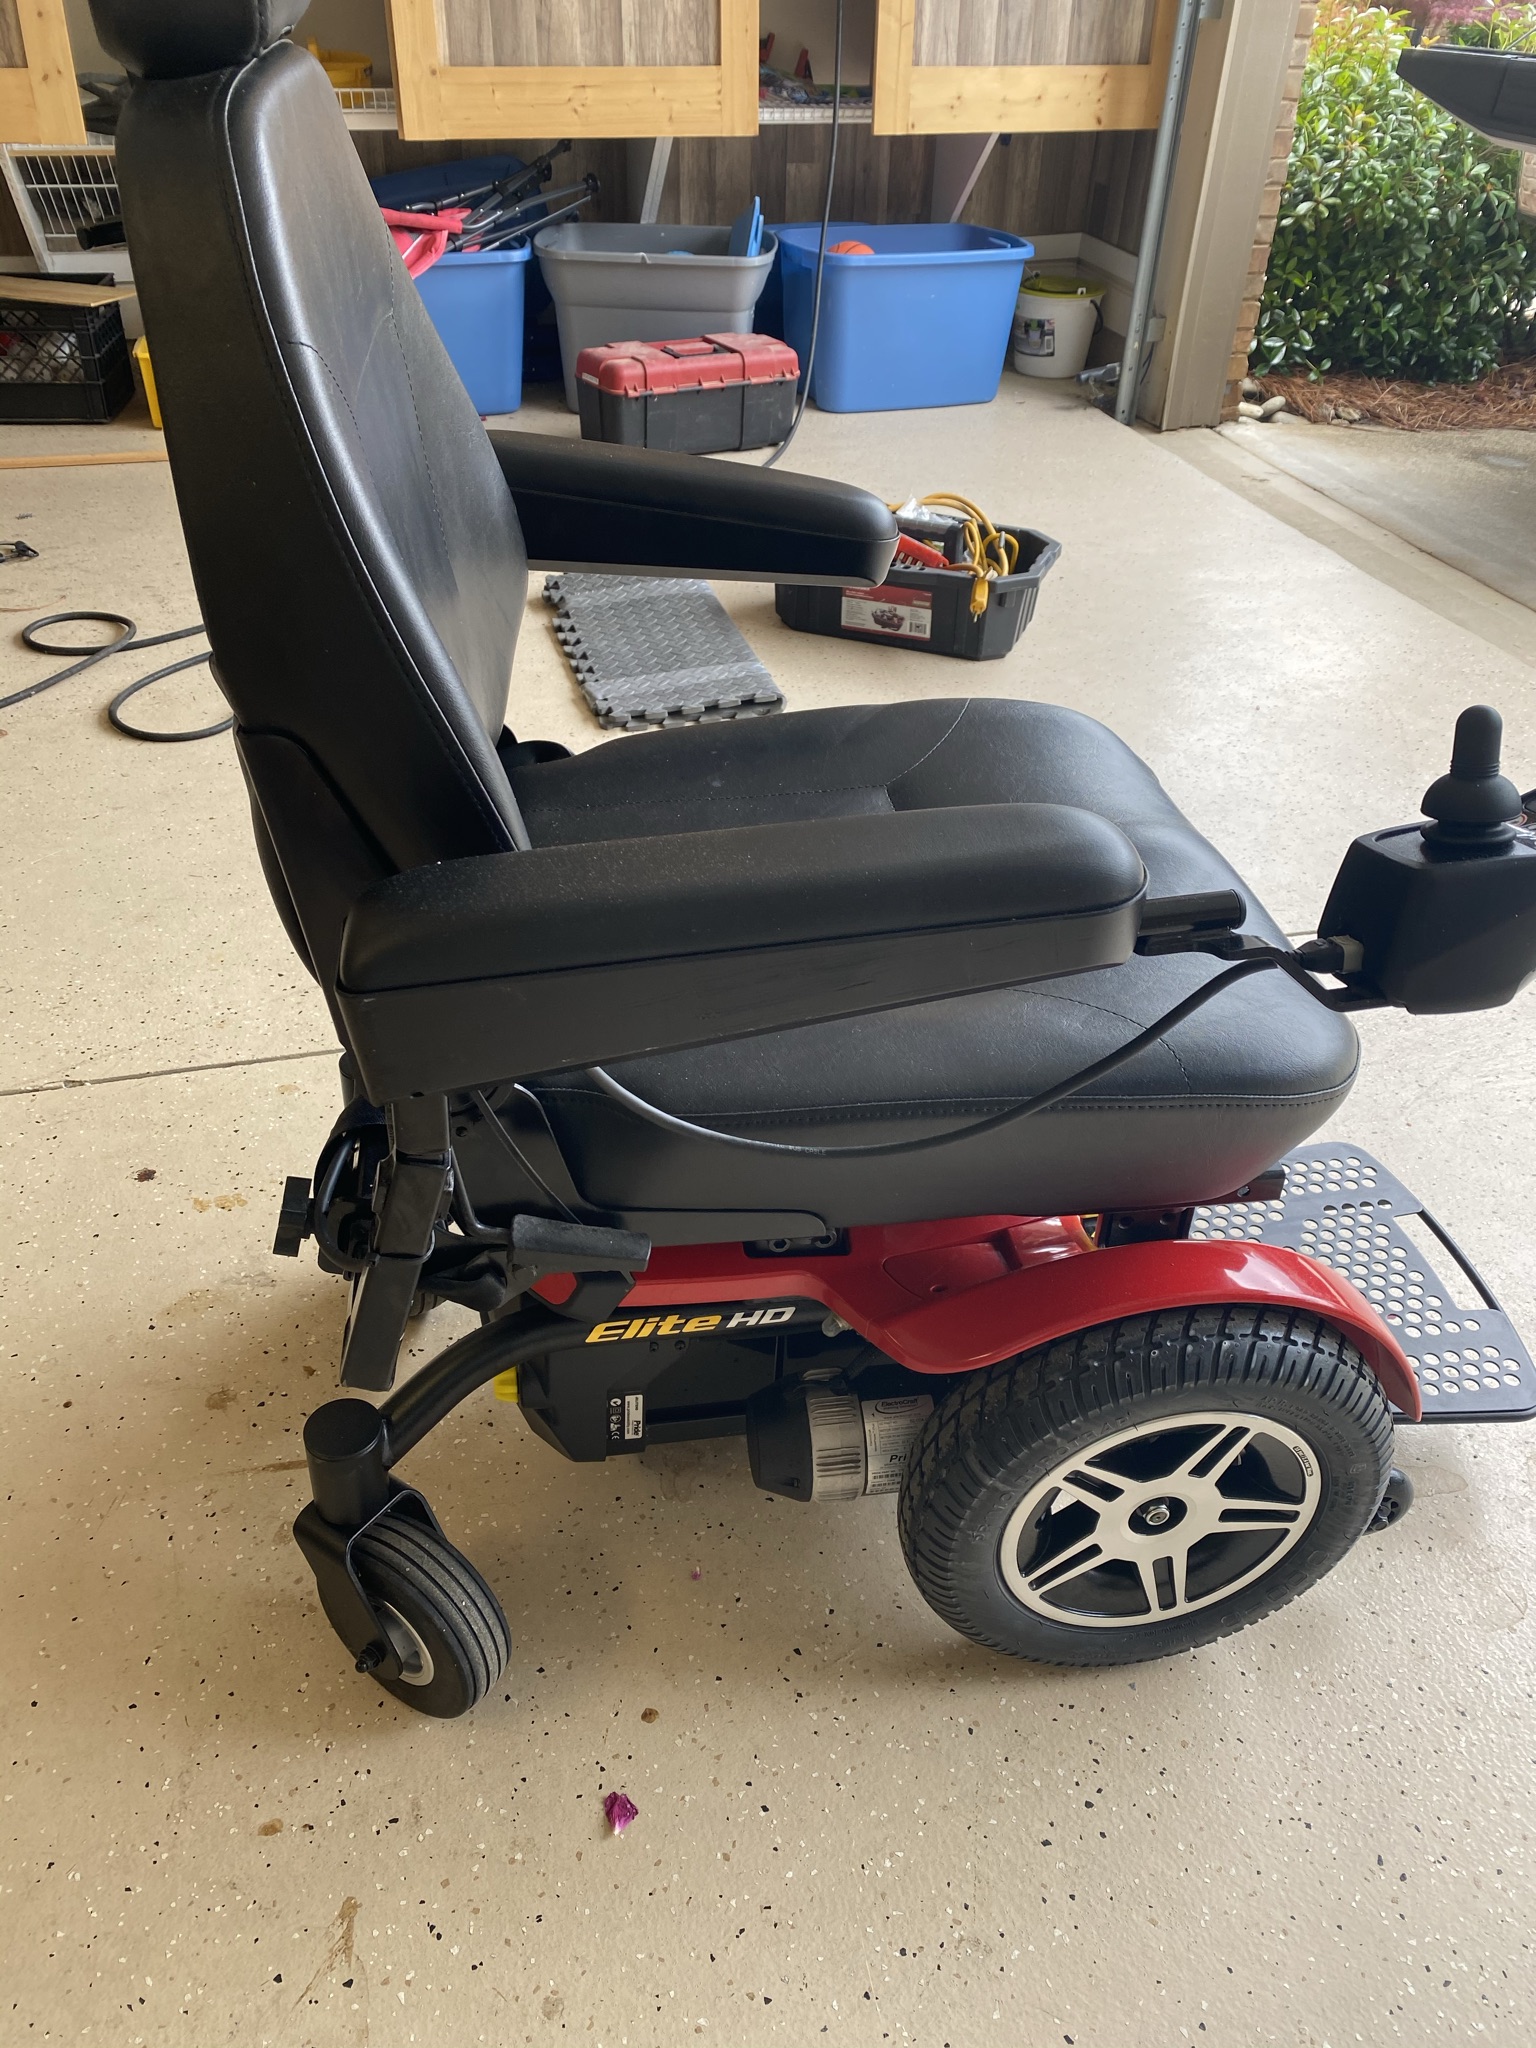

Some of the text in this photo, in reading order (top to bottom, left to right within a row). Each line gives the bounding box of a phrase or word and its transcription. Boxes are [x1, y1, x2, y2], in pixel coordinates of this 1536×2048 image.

[585, 1307, 796, 1343] Elite HD
[881, 1399, 918, 1407] ElectroCraft
[890, 1453, 907, 1462] Pri
